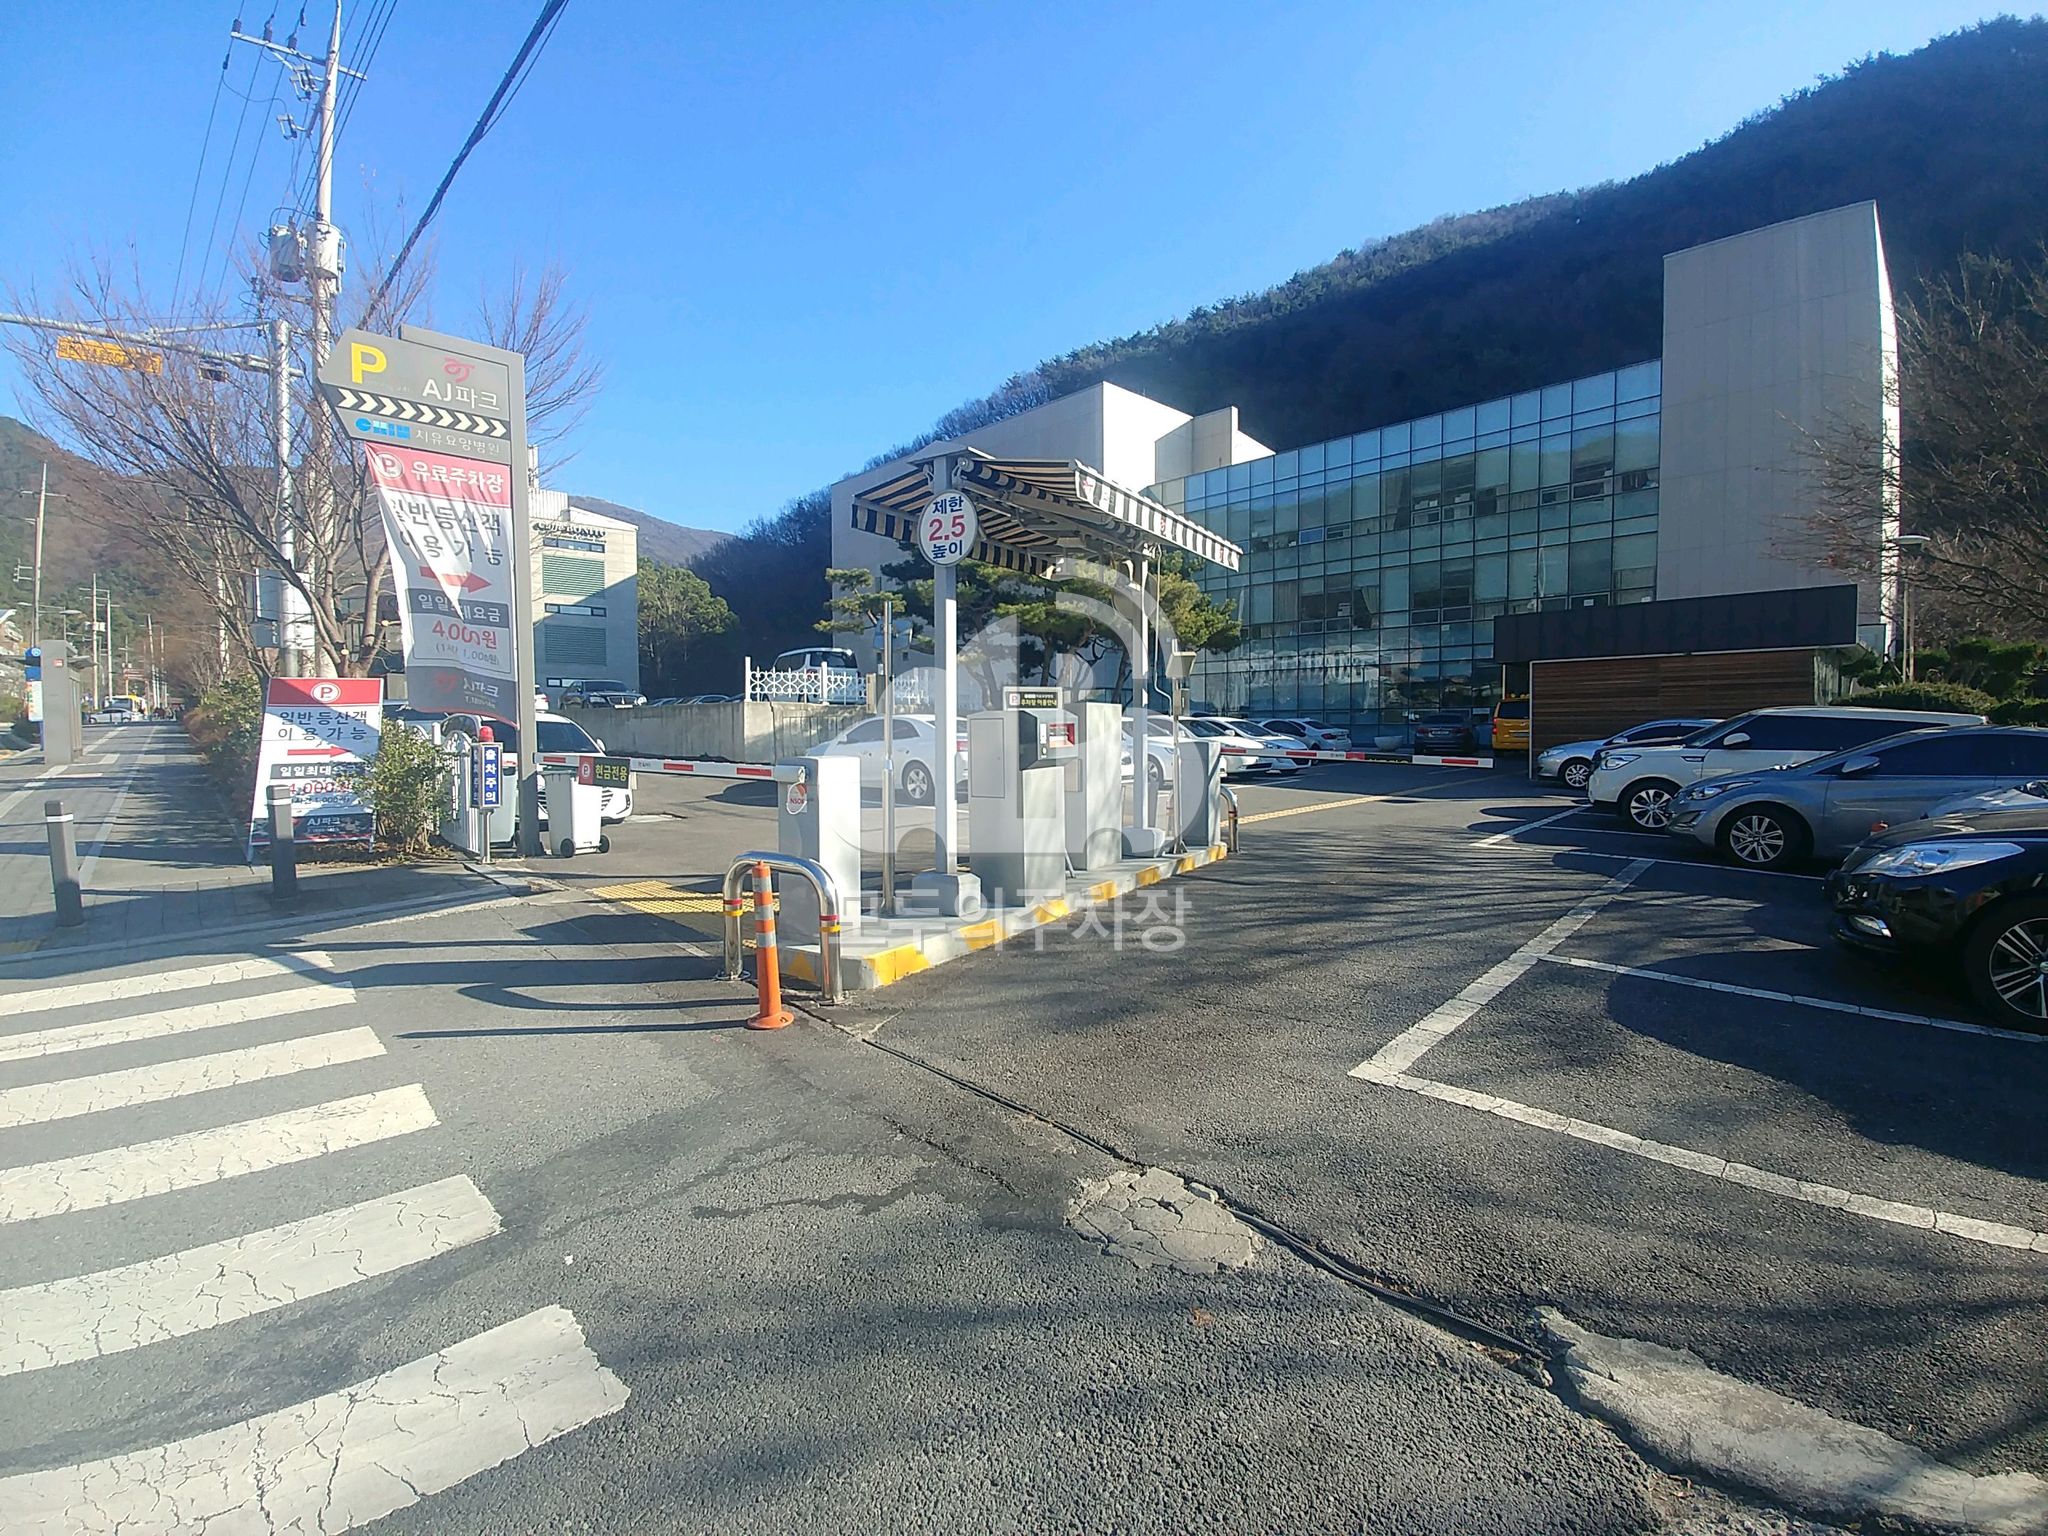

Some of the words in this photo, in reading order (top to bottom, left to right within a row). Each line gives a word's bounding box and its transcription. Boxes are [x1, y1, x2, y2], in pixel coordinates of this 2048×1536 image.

[351, 342, 387, 384] P
[422, 379, 500, 411] AJ파크
[416, 429, 500, 454] 치유요양병원
[411, 461, 504, 493] 유료주차장
[932, 496, 964, 514] 제한
[929, 514, 966, 541] 2.5
[931, 540, 963, 559] 높이
[418, 594, 501, 622] 일일대요금
[280, 711, 367, 726] 일반등산객
[595, 764, 628, 782] 현금전용
